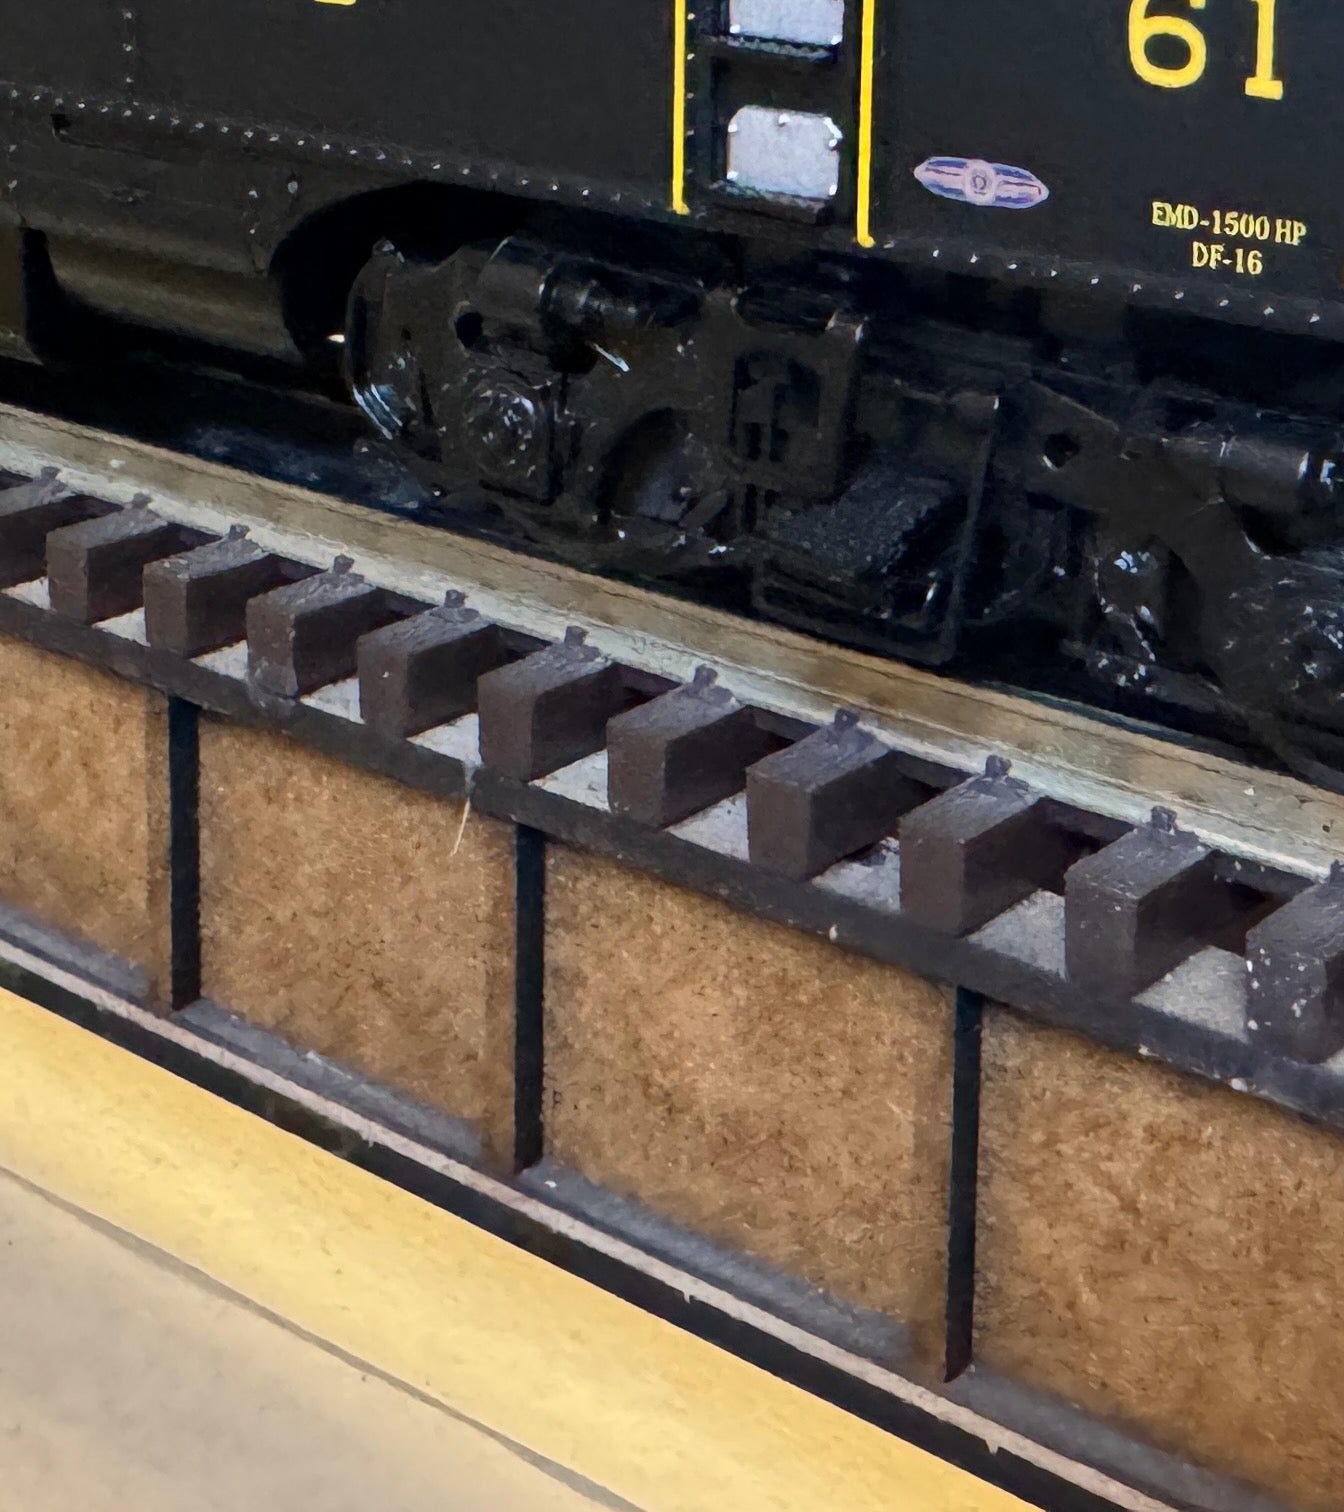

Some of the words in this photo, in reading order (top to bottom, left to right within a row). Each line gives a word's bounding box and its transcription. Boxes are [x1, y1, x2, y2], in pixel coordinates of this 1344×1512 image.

[1151, 201, 1271, 241] EMD-1500
[1275, 218, 1307, 246] HP
[1192, 240, 1264, 276] DF-16
